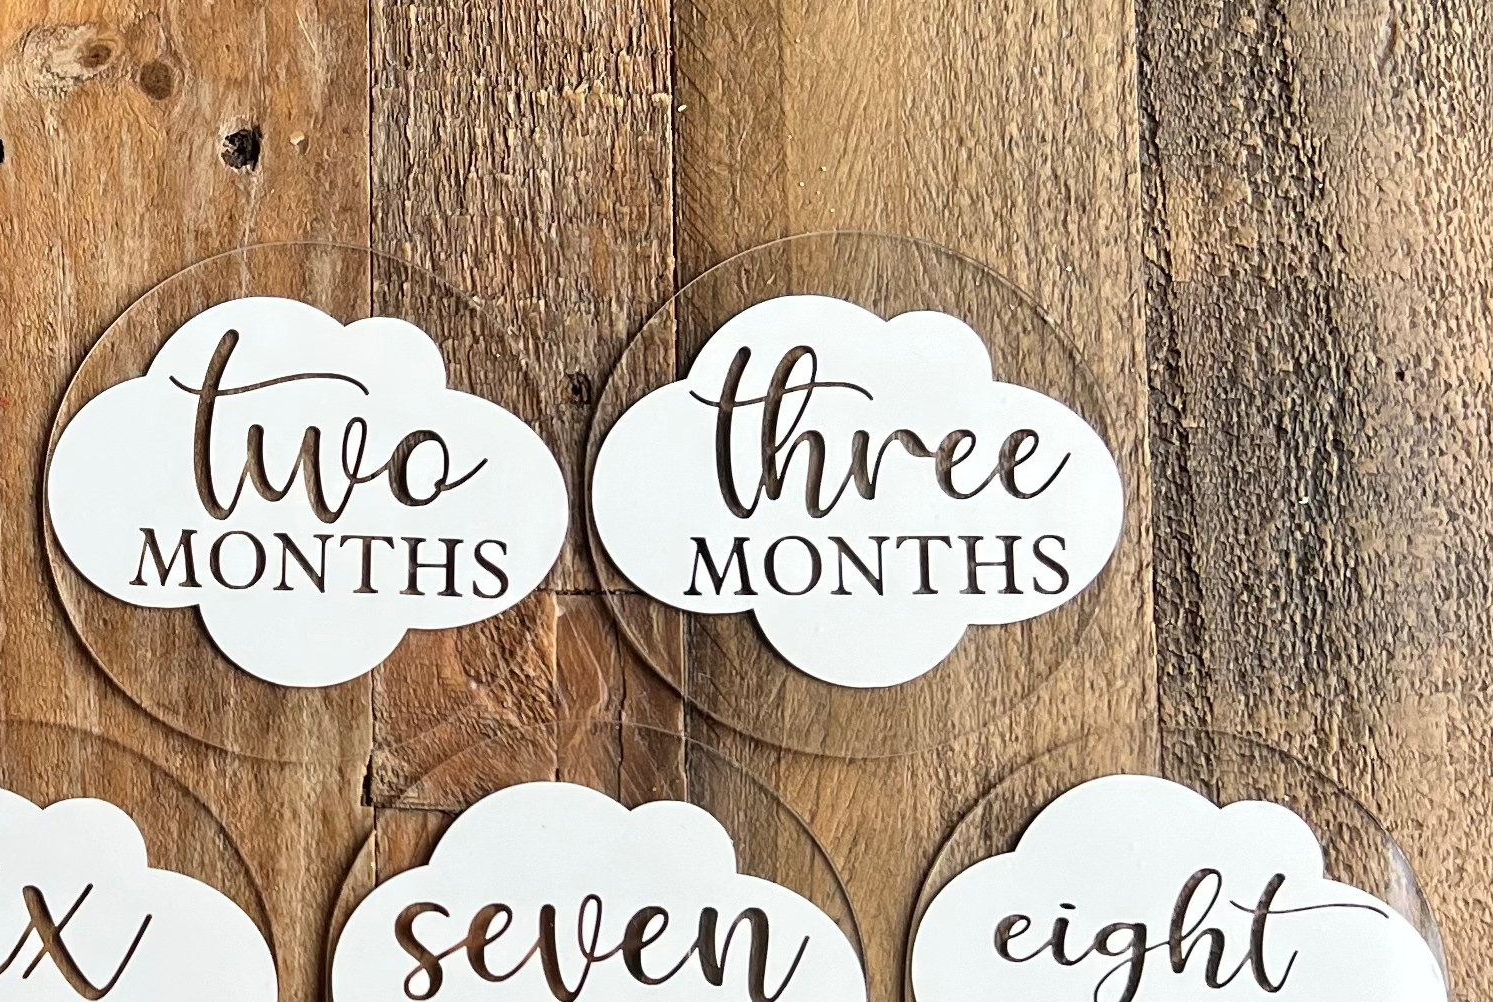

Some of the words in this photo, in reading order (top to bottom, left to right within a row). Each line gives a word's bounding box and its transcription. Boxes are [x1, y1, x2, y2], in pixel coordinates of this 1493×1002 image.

[169, 329, 488, 524] two
[689, 346, 1071, 519] three
[129, 528, 508, 598] MONTHS
[683, 535, 1069, 596] MONTHS
